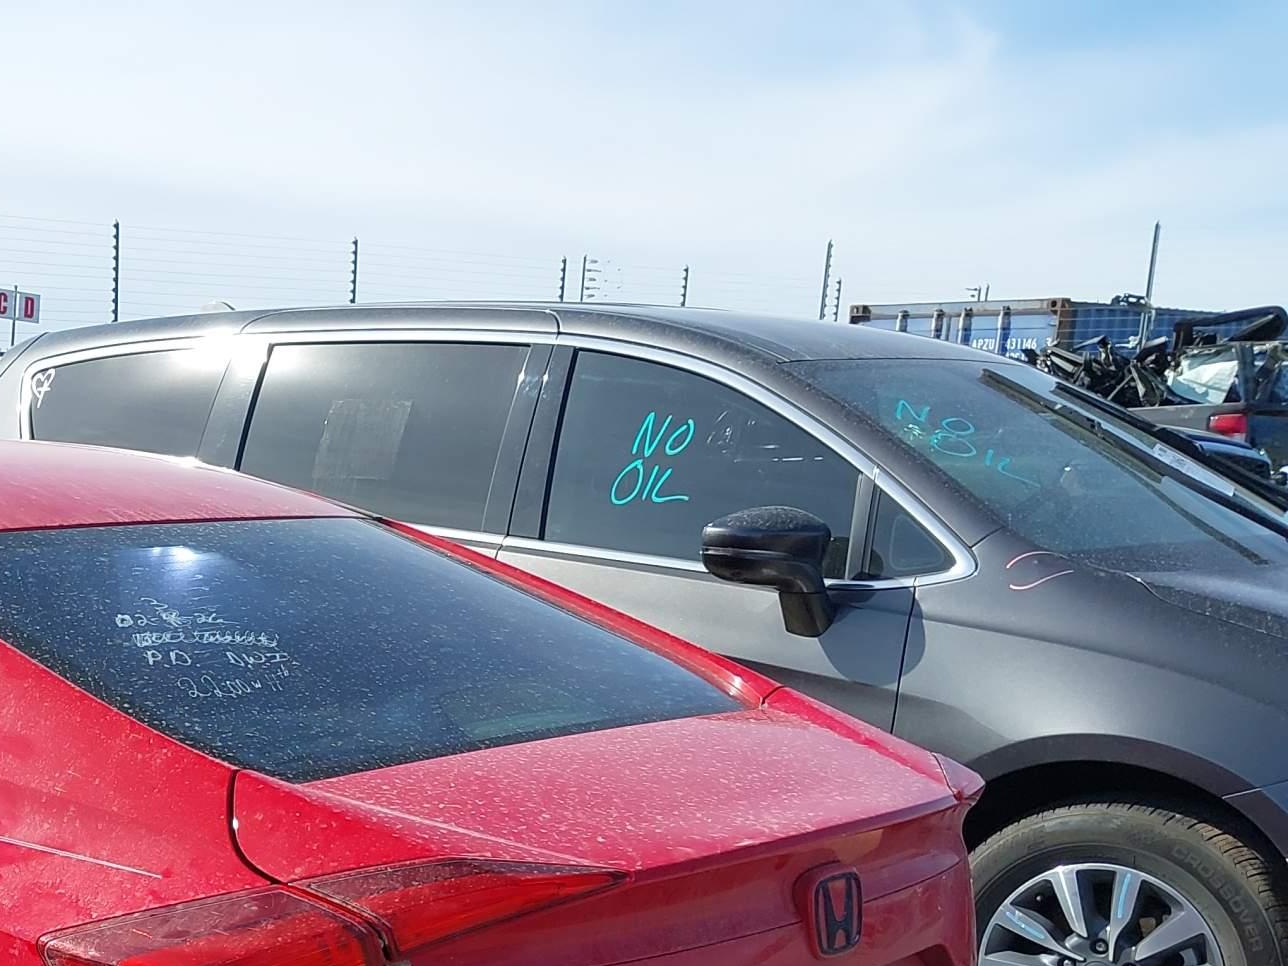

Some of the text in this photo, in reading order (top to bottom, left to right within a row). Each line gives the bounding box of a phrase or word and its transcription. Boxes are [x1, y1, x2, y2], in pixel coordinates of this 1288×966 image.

[24, 296, 35, 319] D
[631, 411, 696, 457] NO
[610, 458, 690, 505] OIL
